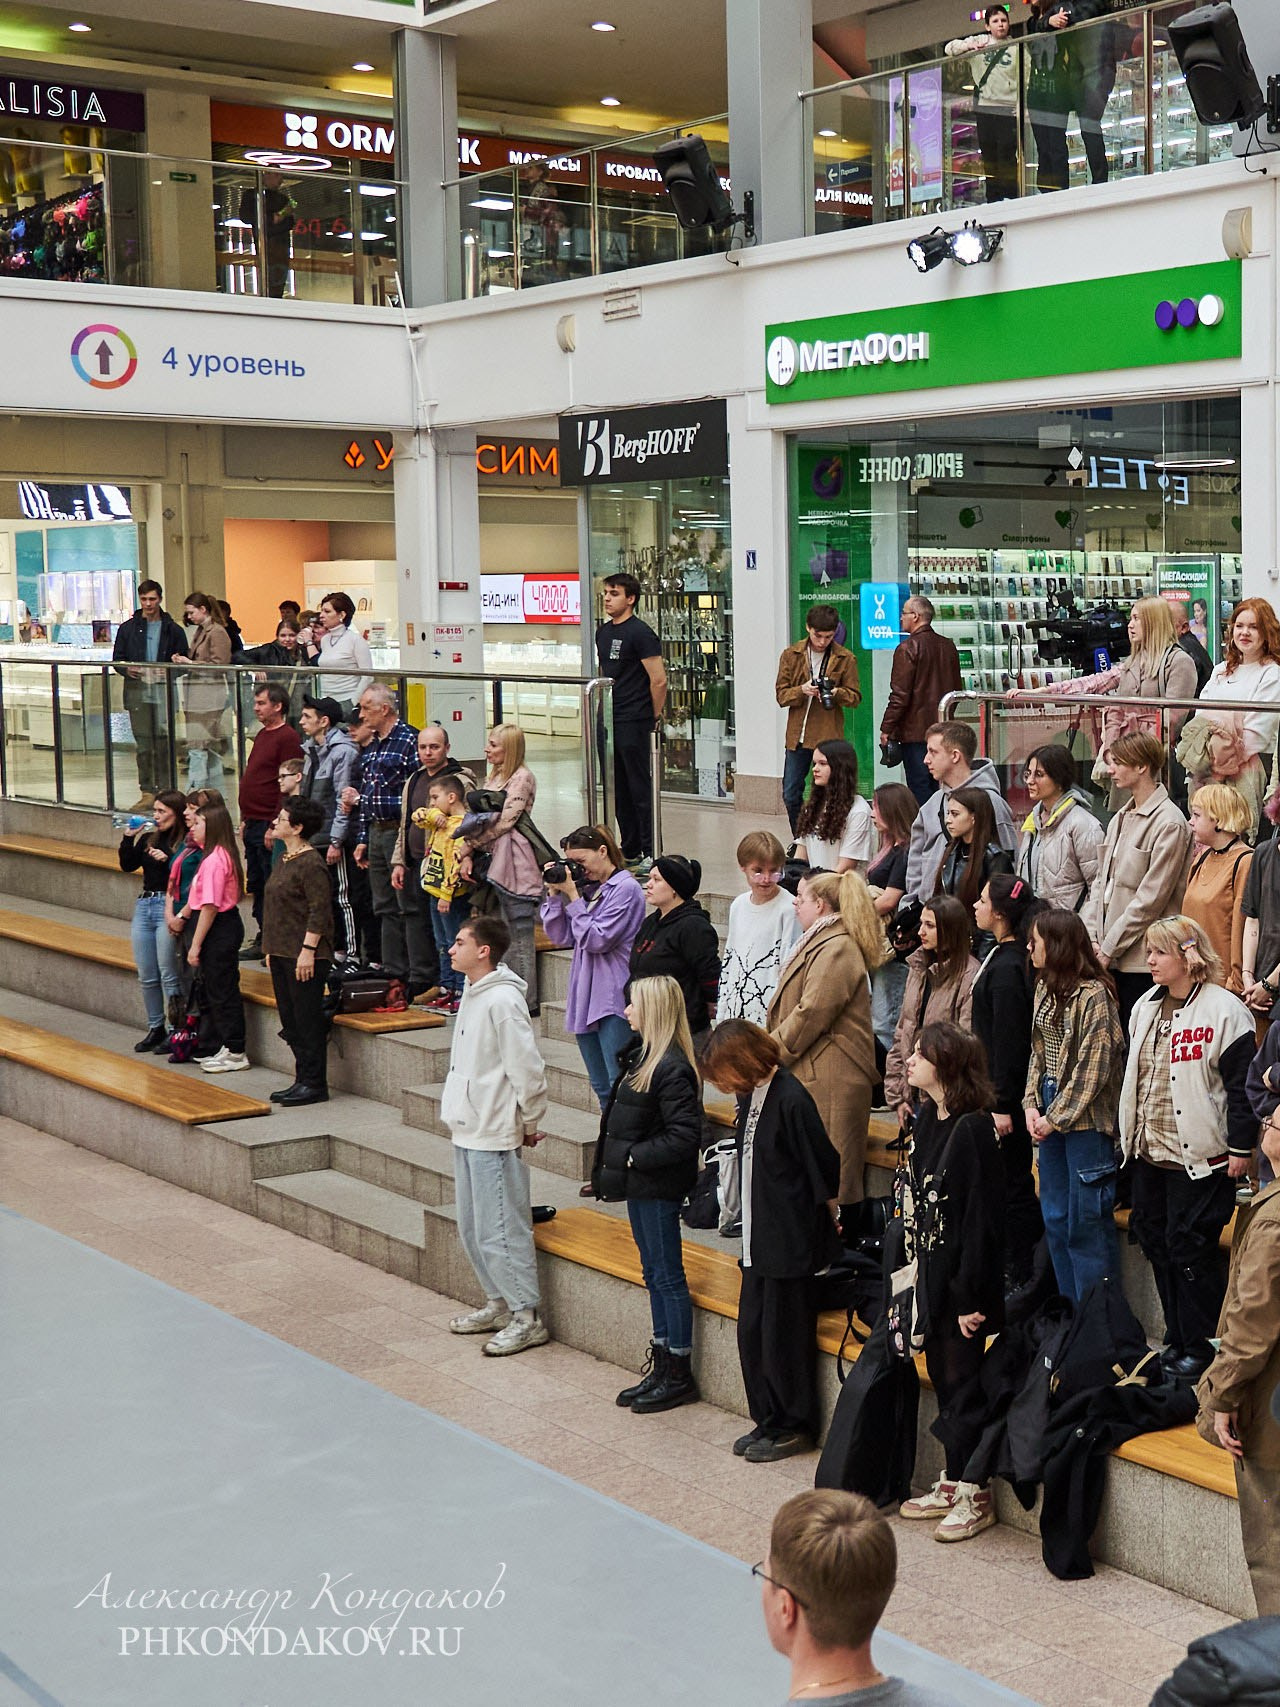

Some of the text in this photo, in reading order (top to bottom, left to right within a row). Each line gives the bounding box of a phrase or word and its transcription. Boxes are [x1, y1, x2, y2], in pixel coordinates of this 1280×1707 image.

[327, 122, 481, 166] ORMK
[816, 188, 842, 202] ДЛЯ
[162, 347, 305, 378] 4 уровень
[612, 425, 698, 463] BergHOFF
[532, 584, 569, 612] 4000
[867, 626, 894, 638] YOTA
